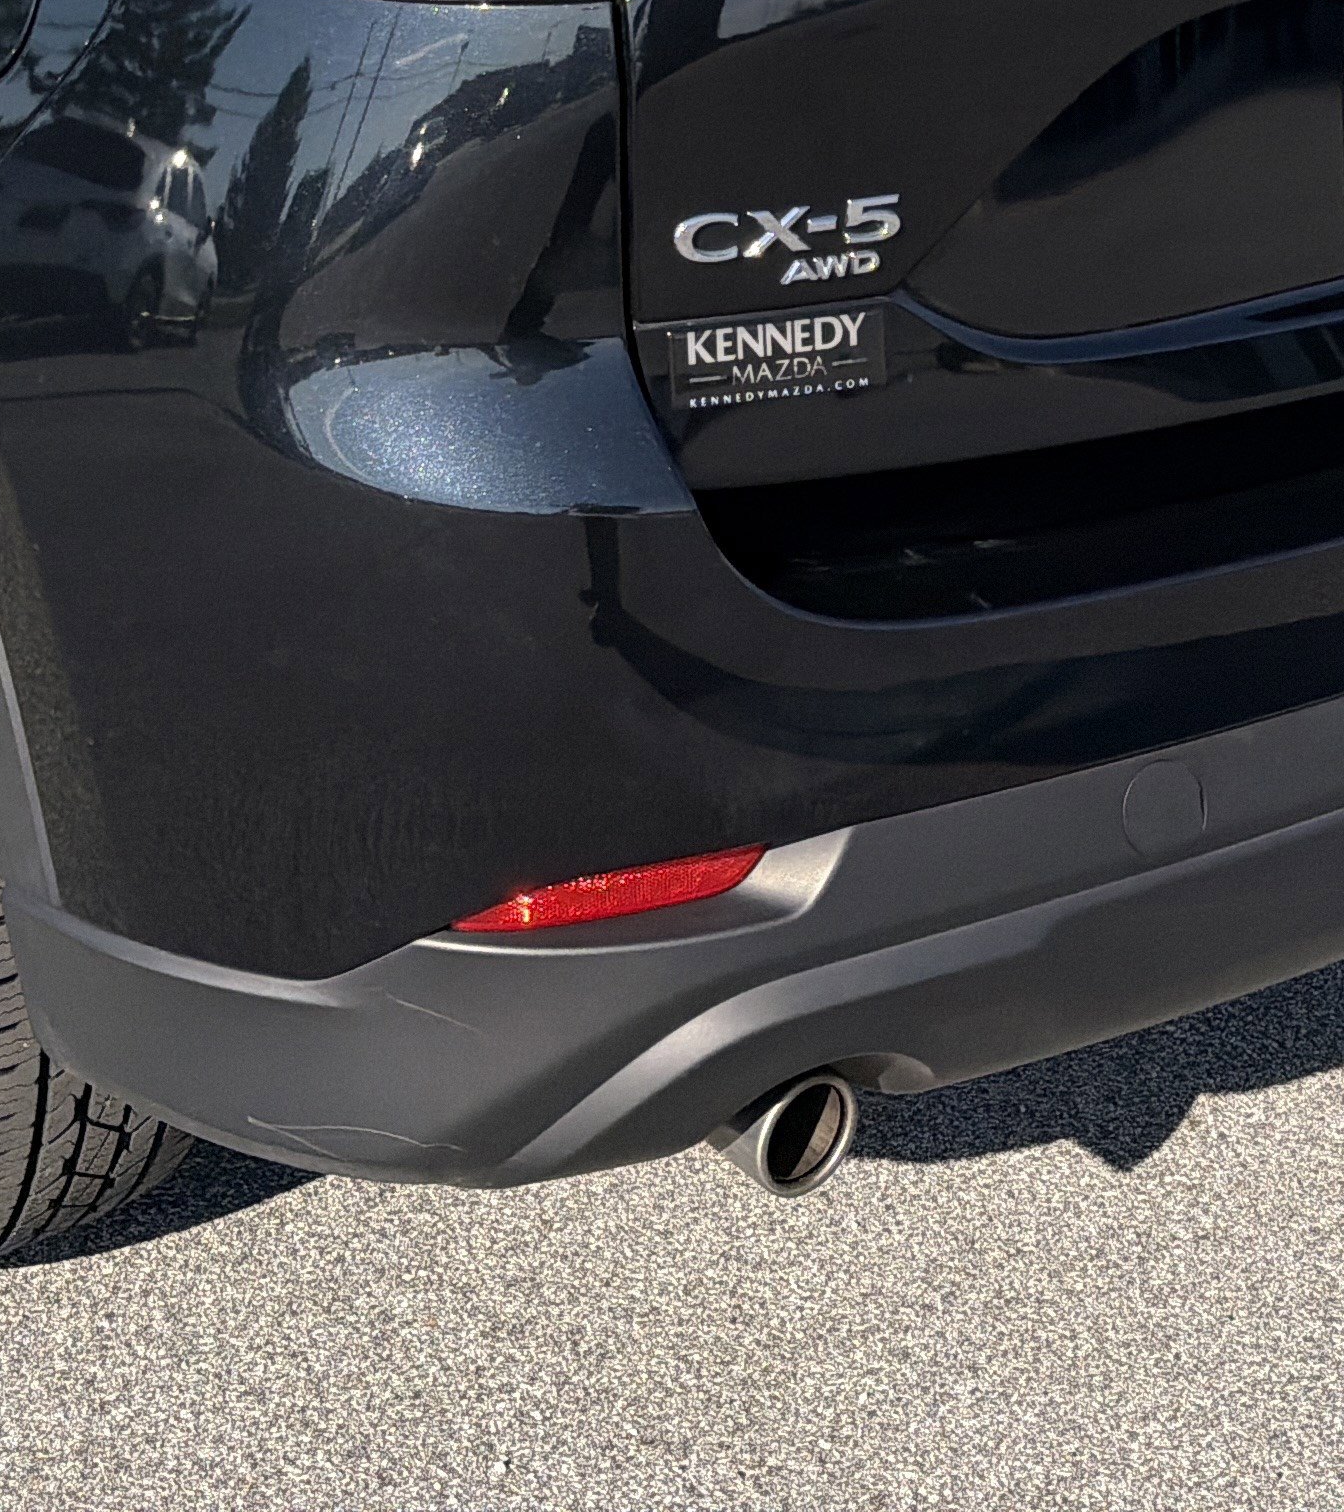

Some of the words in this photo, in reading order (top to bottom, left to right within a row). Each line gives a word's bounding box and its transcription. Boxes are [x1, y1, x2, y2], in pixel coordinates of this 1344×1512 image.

[673, 193, 902, 264] CX-5
[779, 249, 881, 286] AWD
[686, 311, 867, 366] KENNEDY
[732, 355, 828, 386] MAZDA
[689, 377, 870, 409] KENNEDYMAZDA.COM
